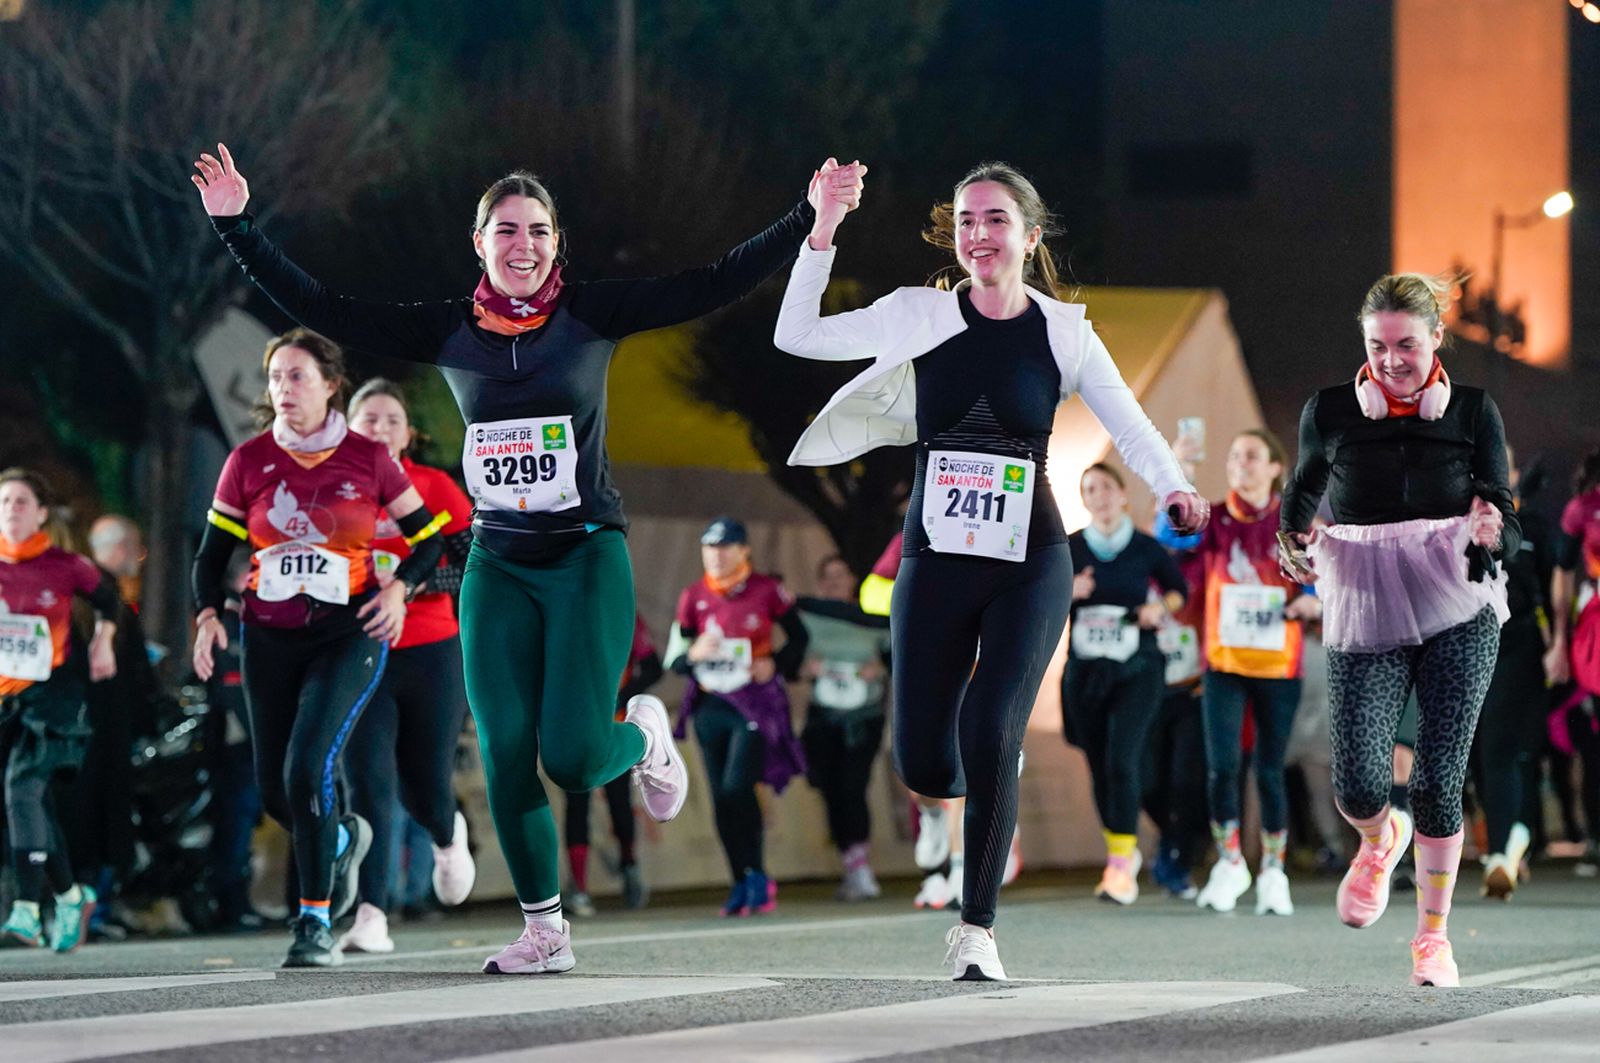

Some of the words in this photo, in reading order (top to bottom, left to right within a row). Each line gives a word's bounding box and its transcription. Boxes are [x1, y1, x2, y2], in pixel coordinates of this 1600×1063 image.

[486, 431, 517, 443] NOCHE
[519, 430, 532, 440] DE
[475, 446, 494, 456] SAN
[497, 440, 533, 454] ANTÓN
[483, 453, 557, 486] 3299
[949, 463, 980, 474] NOCHE
[981, 466, 995, 476] DE
[938, 475, 955, 485] SAN
[957, 475, 993, 488] ANTÓN
[945, 488, 1007, 523] 2411
[285, 517, 309, 537] 43
[280, 553, 329, 576] 6112
